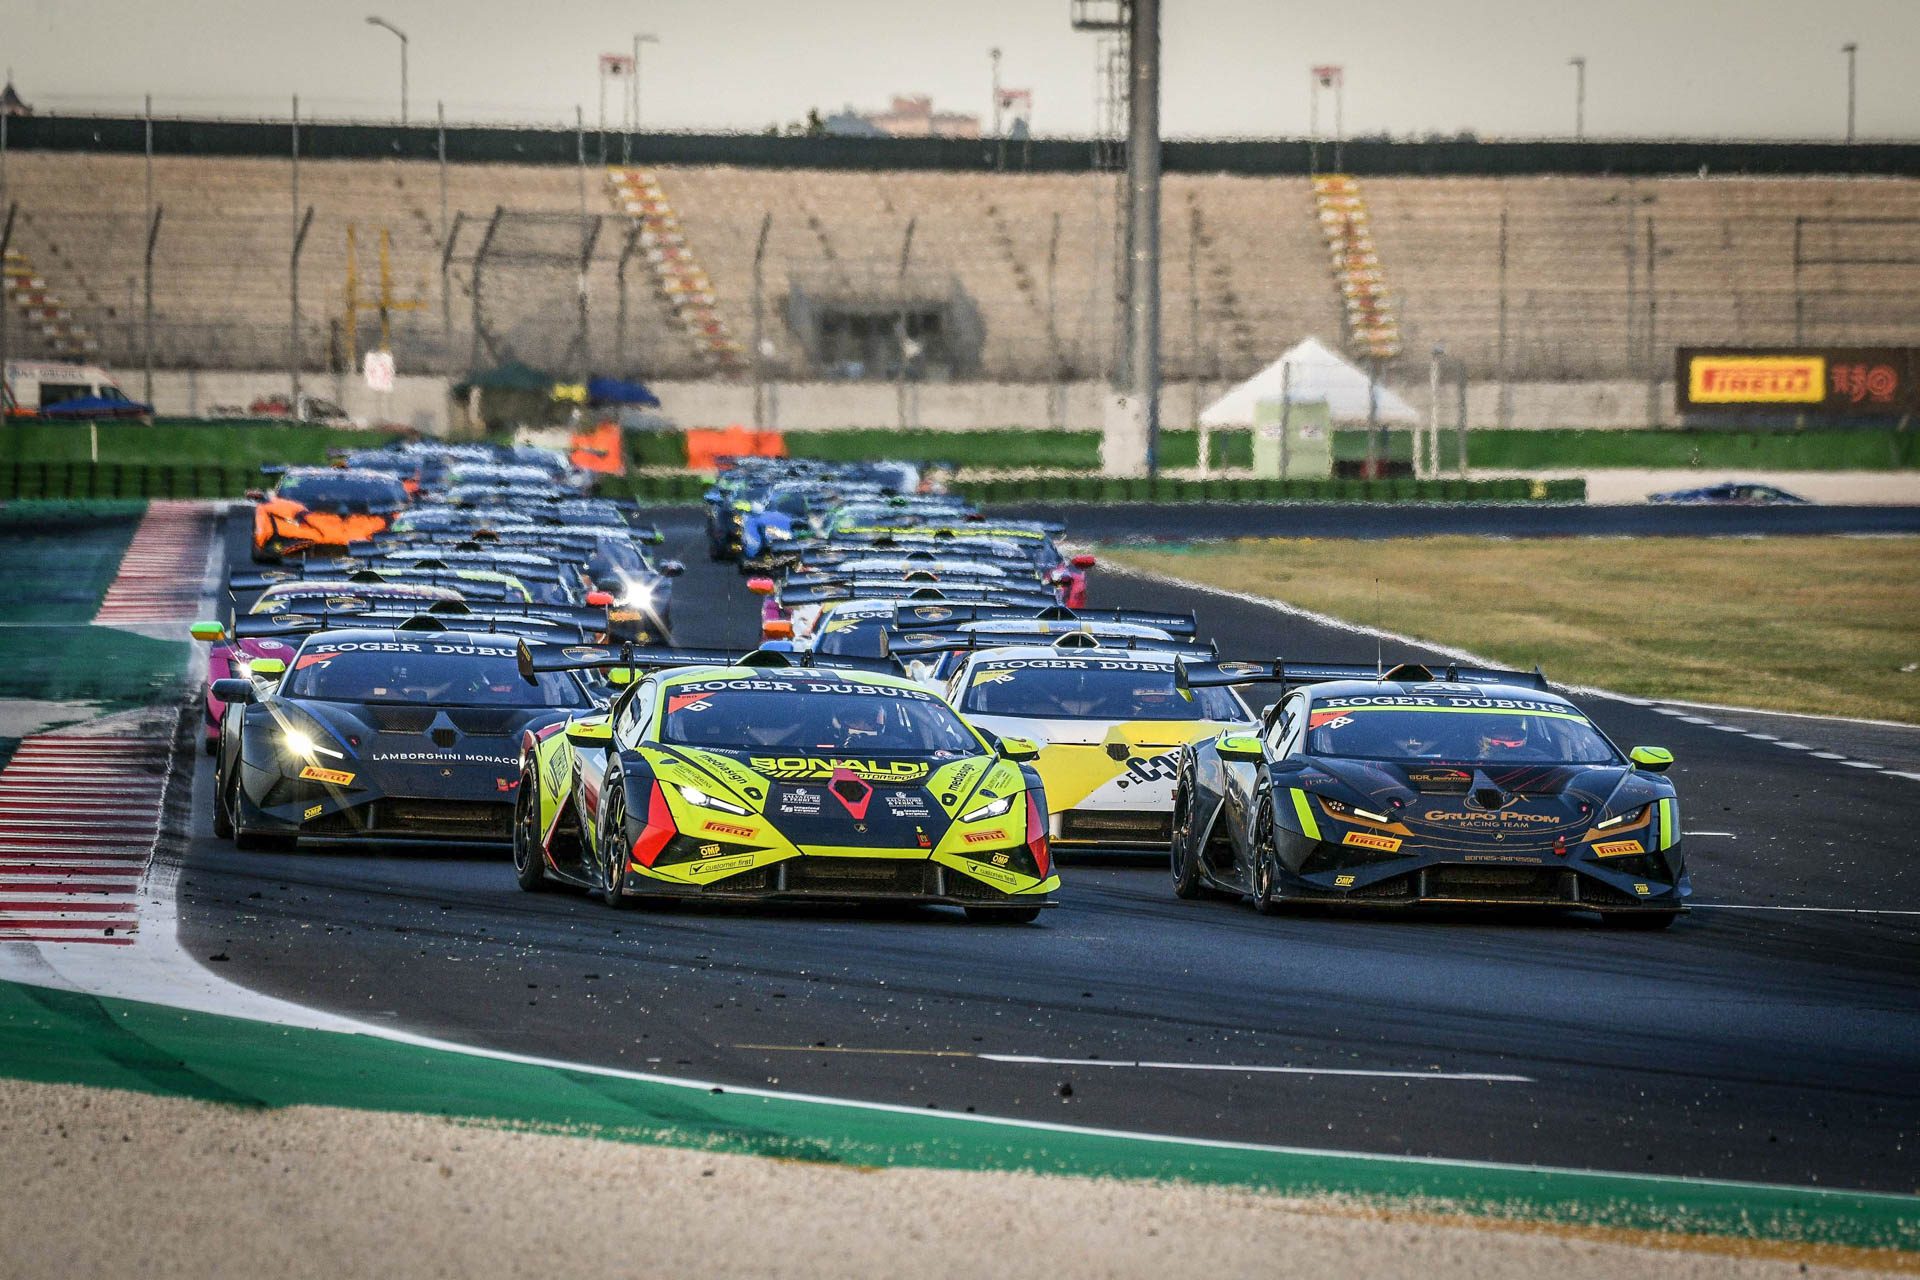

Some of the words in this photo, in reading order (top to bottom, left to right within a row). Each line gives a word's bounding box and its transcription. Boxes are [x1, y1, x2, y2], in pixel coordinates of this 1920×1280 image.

[1702, 367, 1811, 393] PIRELLI
[315, 642, 422, 654] ROGER
[318, 660, 333, 669] 7
[986, 660, 1088, 670] ROGER
[680, 680, 797, 693] ROGER
[807, 684, 931, 701] DUBUIS
[683, 700, 714, 712] 61
[1326, 696, 1445, 708] ROGER
[1448, 698, 1568, 714] DUBUIS
[1322, 716, 1355, 730] 28
[372, 753, 461, 762] LAMBORGHINI
[465, 754, 520, 765] MONACO
[749, 757, 931, 778] BONALDI
[305, 767, 349, 783] PIRELLI
[948, 763, 976, 792] mediasign
[303, 805, 323, 820] OMP
[1424, 810, 1497, 821] GRUPO
[1500, 811, 1561, 824] PROM
[704, 822, 754, 838] PIRELLI
[1460, 820, 1500, 828] RACING
[1502, 821, 1530, 829] TEAM
[963, 830, 1006, 844] PIRELLI
[1348, 834, 1396, 849] PIRELLI
[700, 844, 722, 858] OMP
[1597, 843, 1639, 854] PIRELLI
[705, 861, 737, 872] customer
[738, 858, 752, 867] first
[991, 853, 1010, 867] OMP
[1335, 875, 1355, 887] OMP
